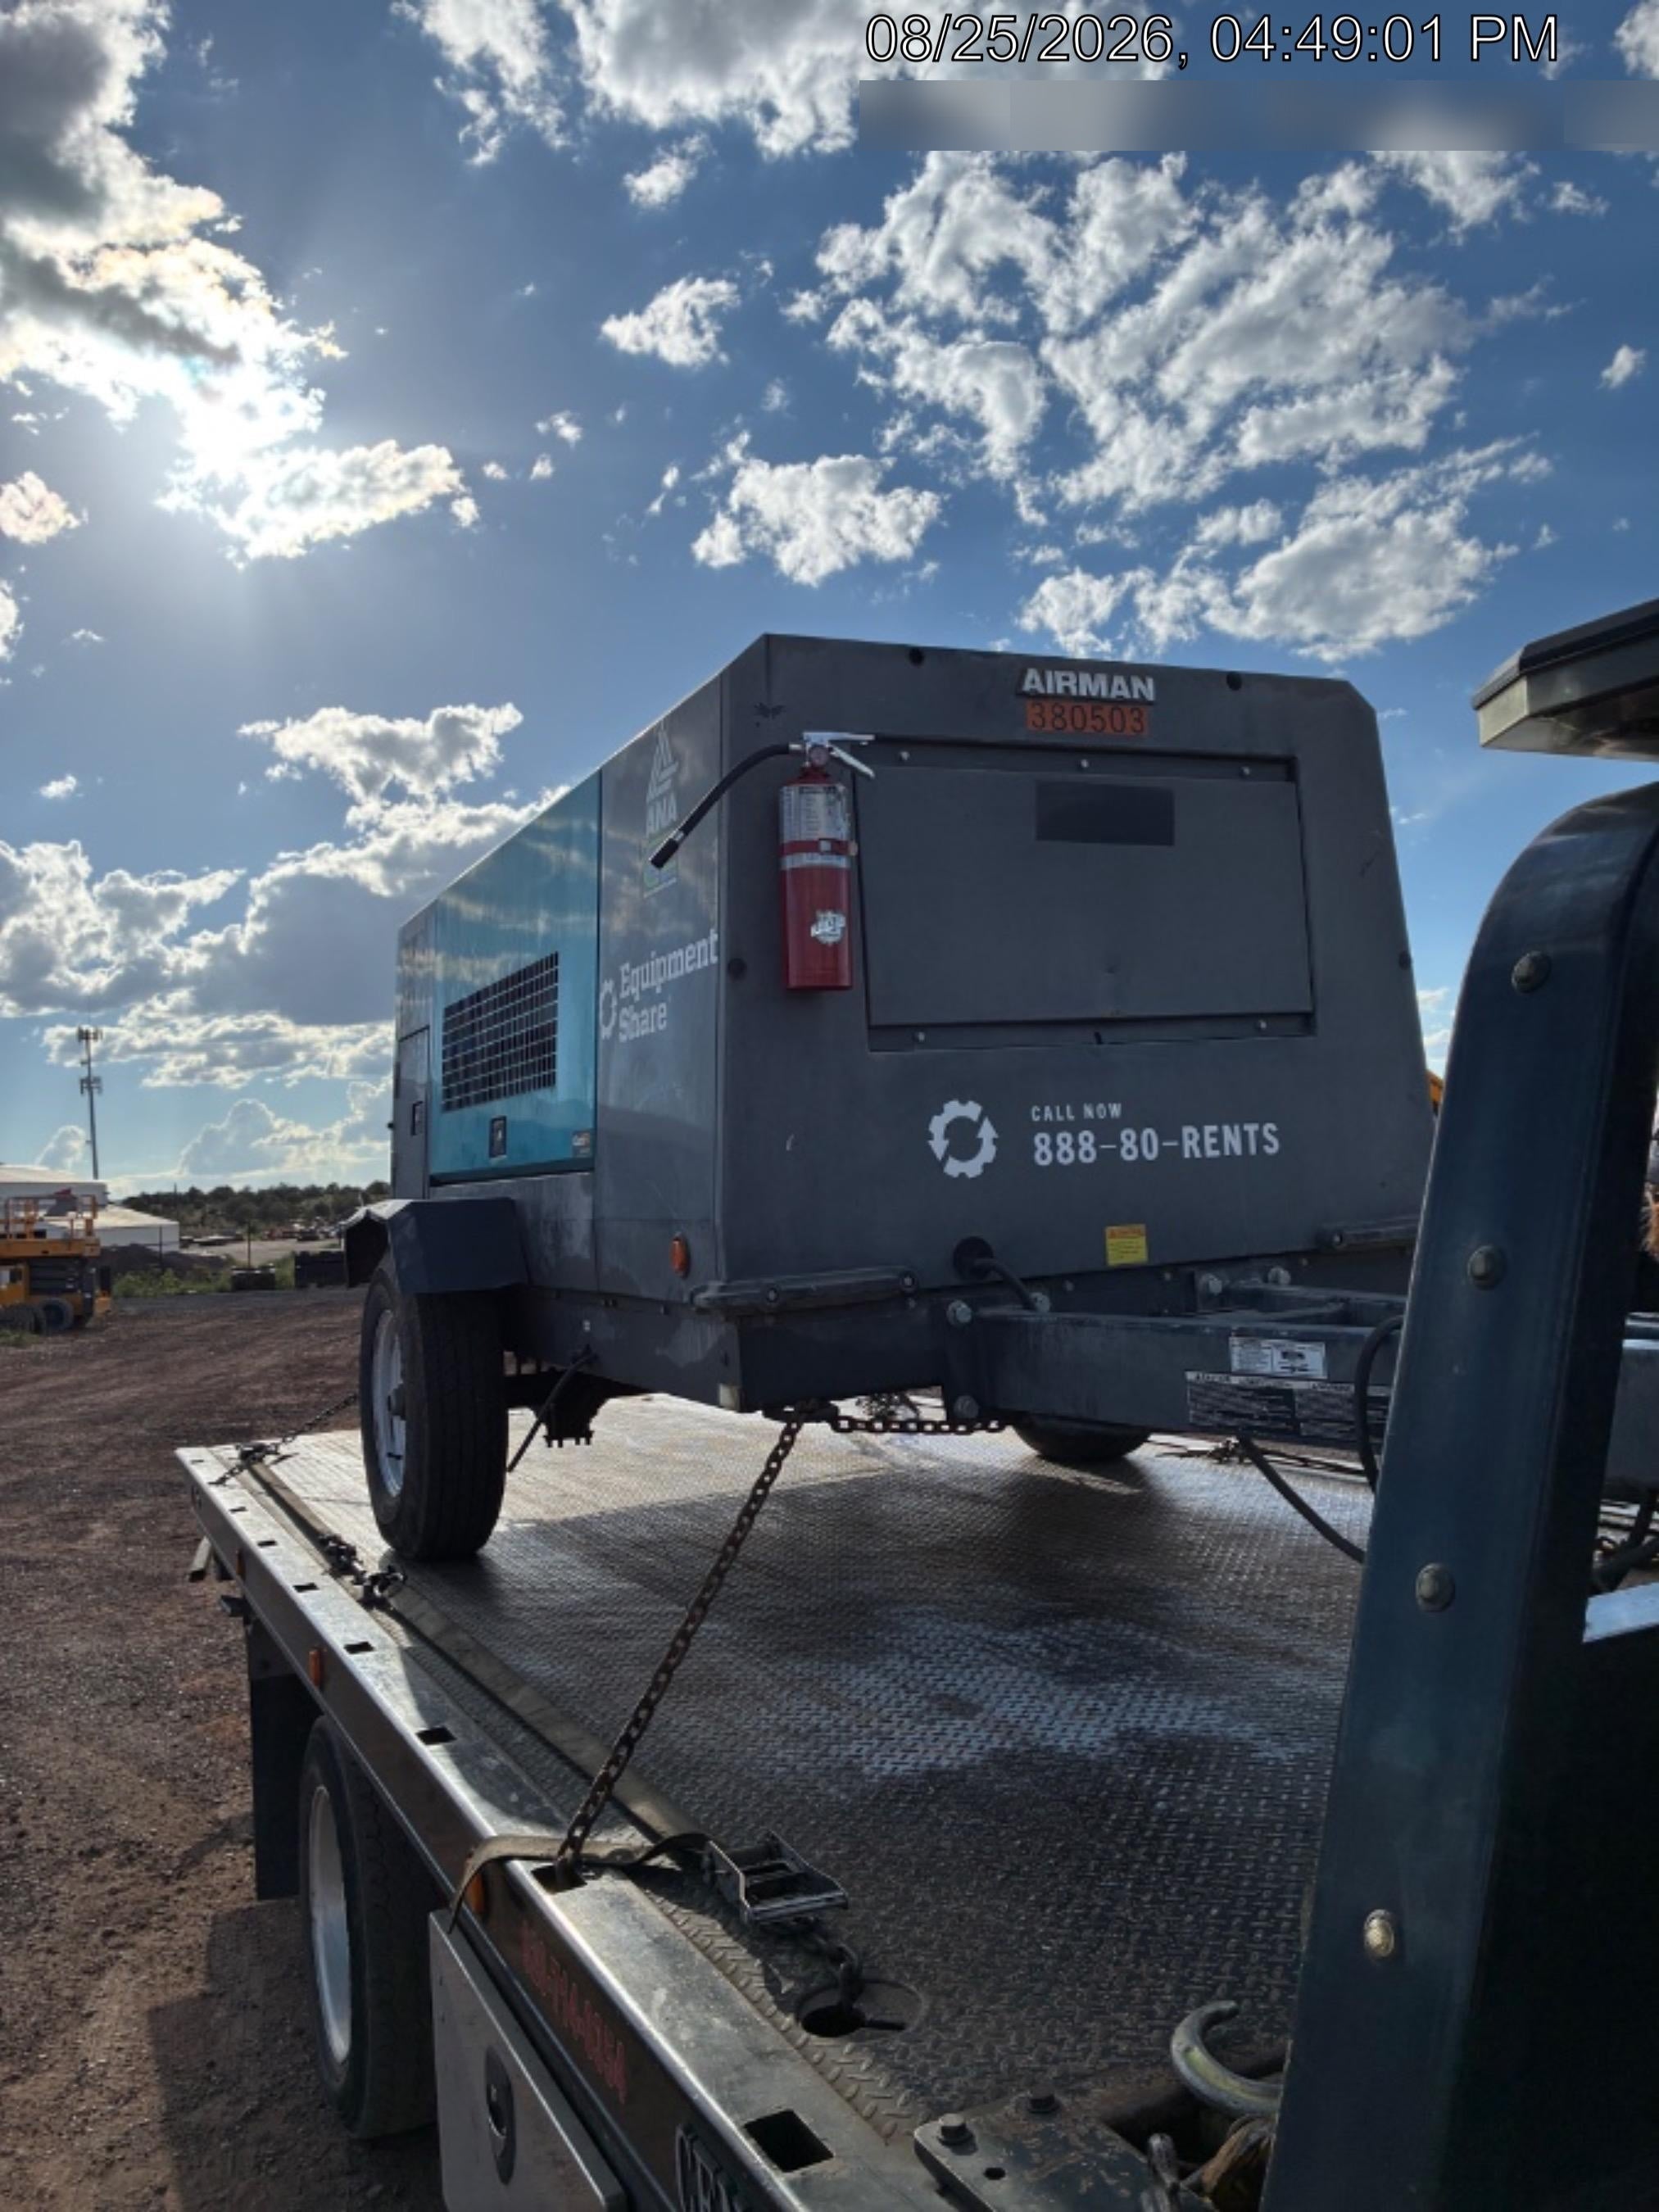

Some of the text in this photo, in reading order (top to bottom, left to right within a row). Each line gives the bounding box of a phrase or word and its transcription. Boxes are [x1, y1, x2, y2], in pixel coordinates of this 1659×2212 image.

[1022, 668, 1156, 701] AIRMAN
[1031, 701, 1145, 734] 380503
[619, 928, 718, 1002] Equipment
[619, 1002, 668, 1043] Share
[1031, 1103, 1122, 1122] CALL NOW
[1033, 1122, 1281, 1167] 888-80-RENTS
